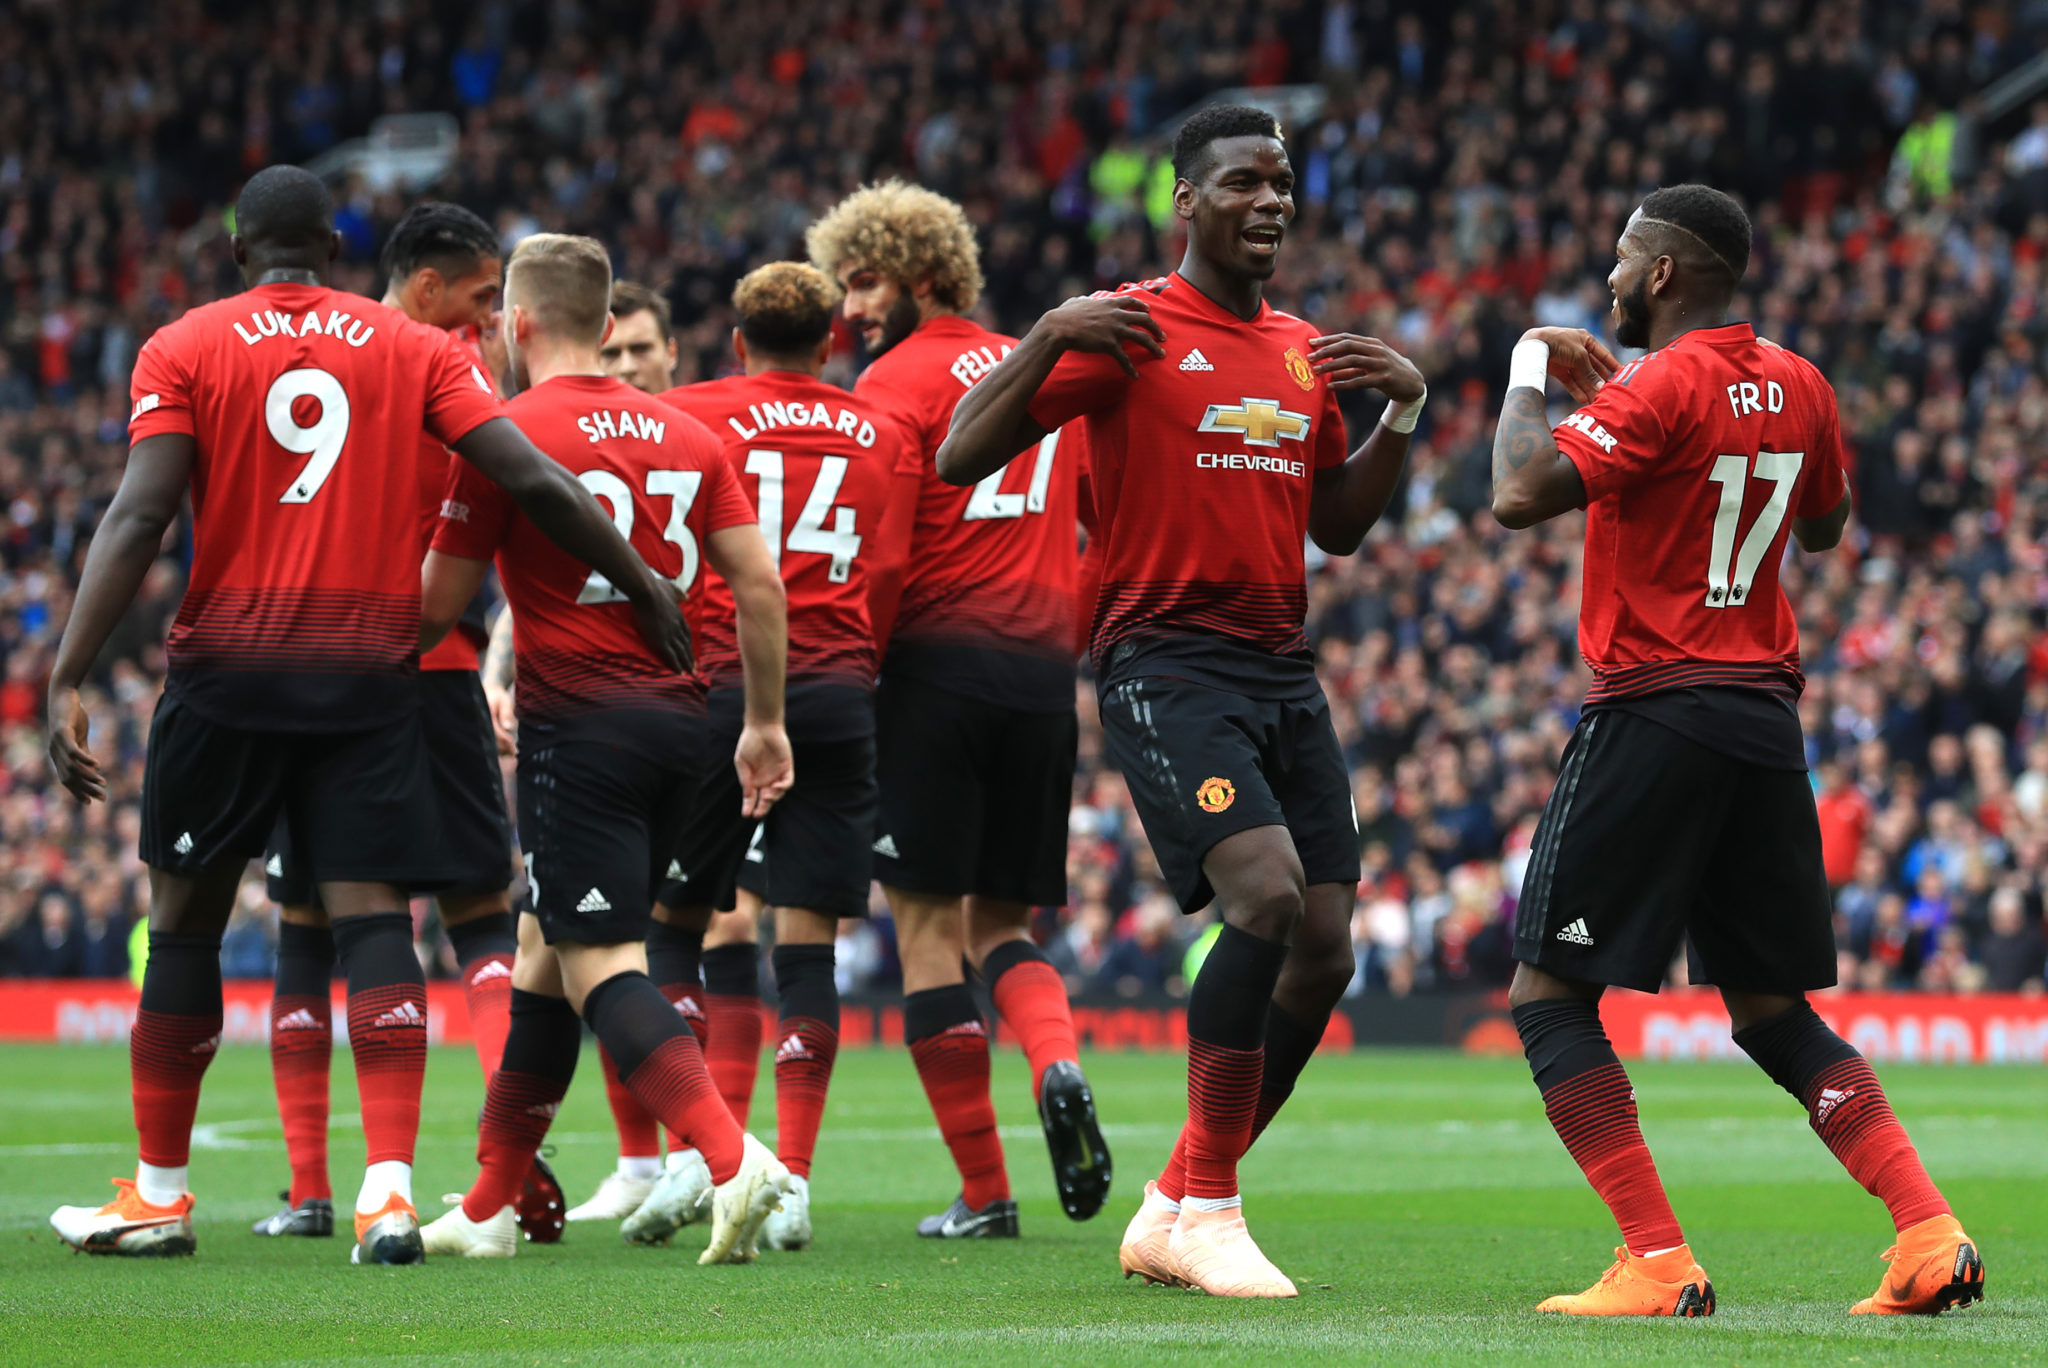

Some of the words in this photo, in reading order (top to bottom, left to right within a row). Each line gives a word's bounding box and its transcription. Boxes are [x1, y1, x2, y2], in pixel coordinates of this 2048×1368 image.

[233, 309, 375, 347] LUKAKU
[1179, 362, 1214, 371] adidas
[265, 367, 350, 503] 9
[577, 409, 665, 444] SHAW
[728, 401, 876, 448] LINGARD
[1196, 453, 1306, 478] CHEVROLET
[744, 449, 862, 583] 14
[1705, 451, 1805, 608] 17
[576, 469, 702, 605] 23
[1556, 930, 1594, 945] adidas
[1819, 1090, 1856, 1124] adidas
